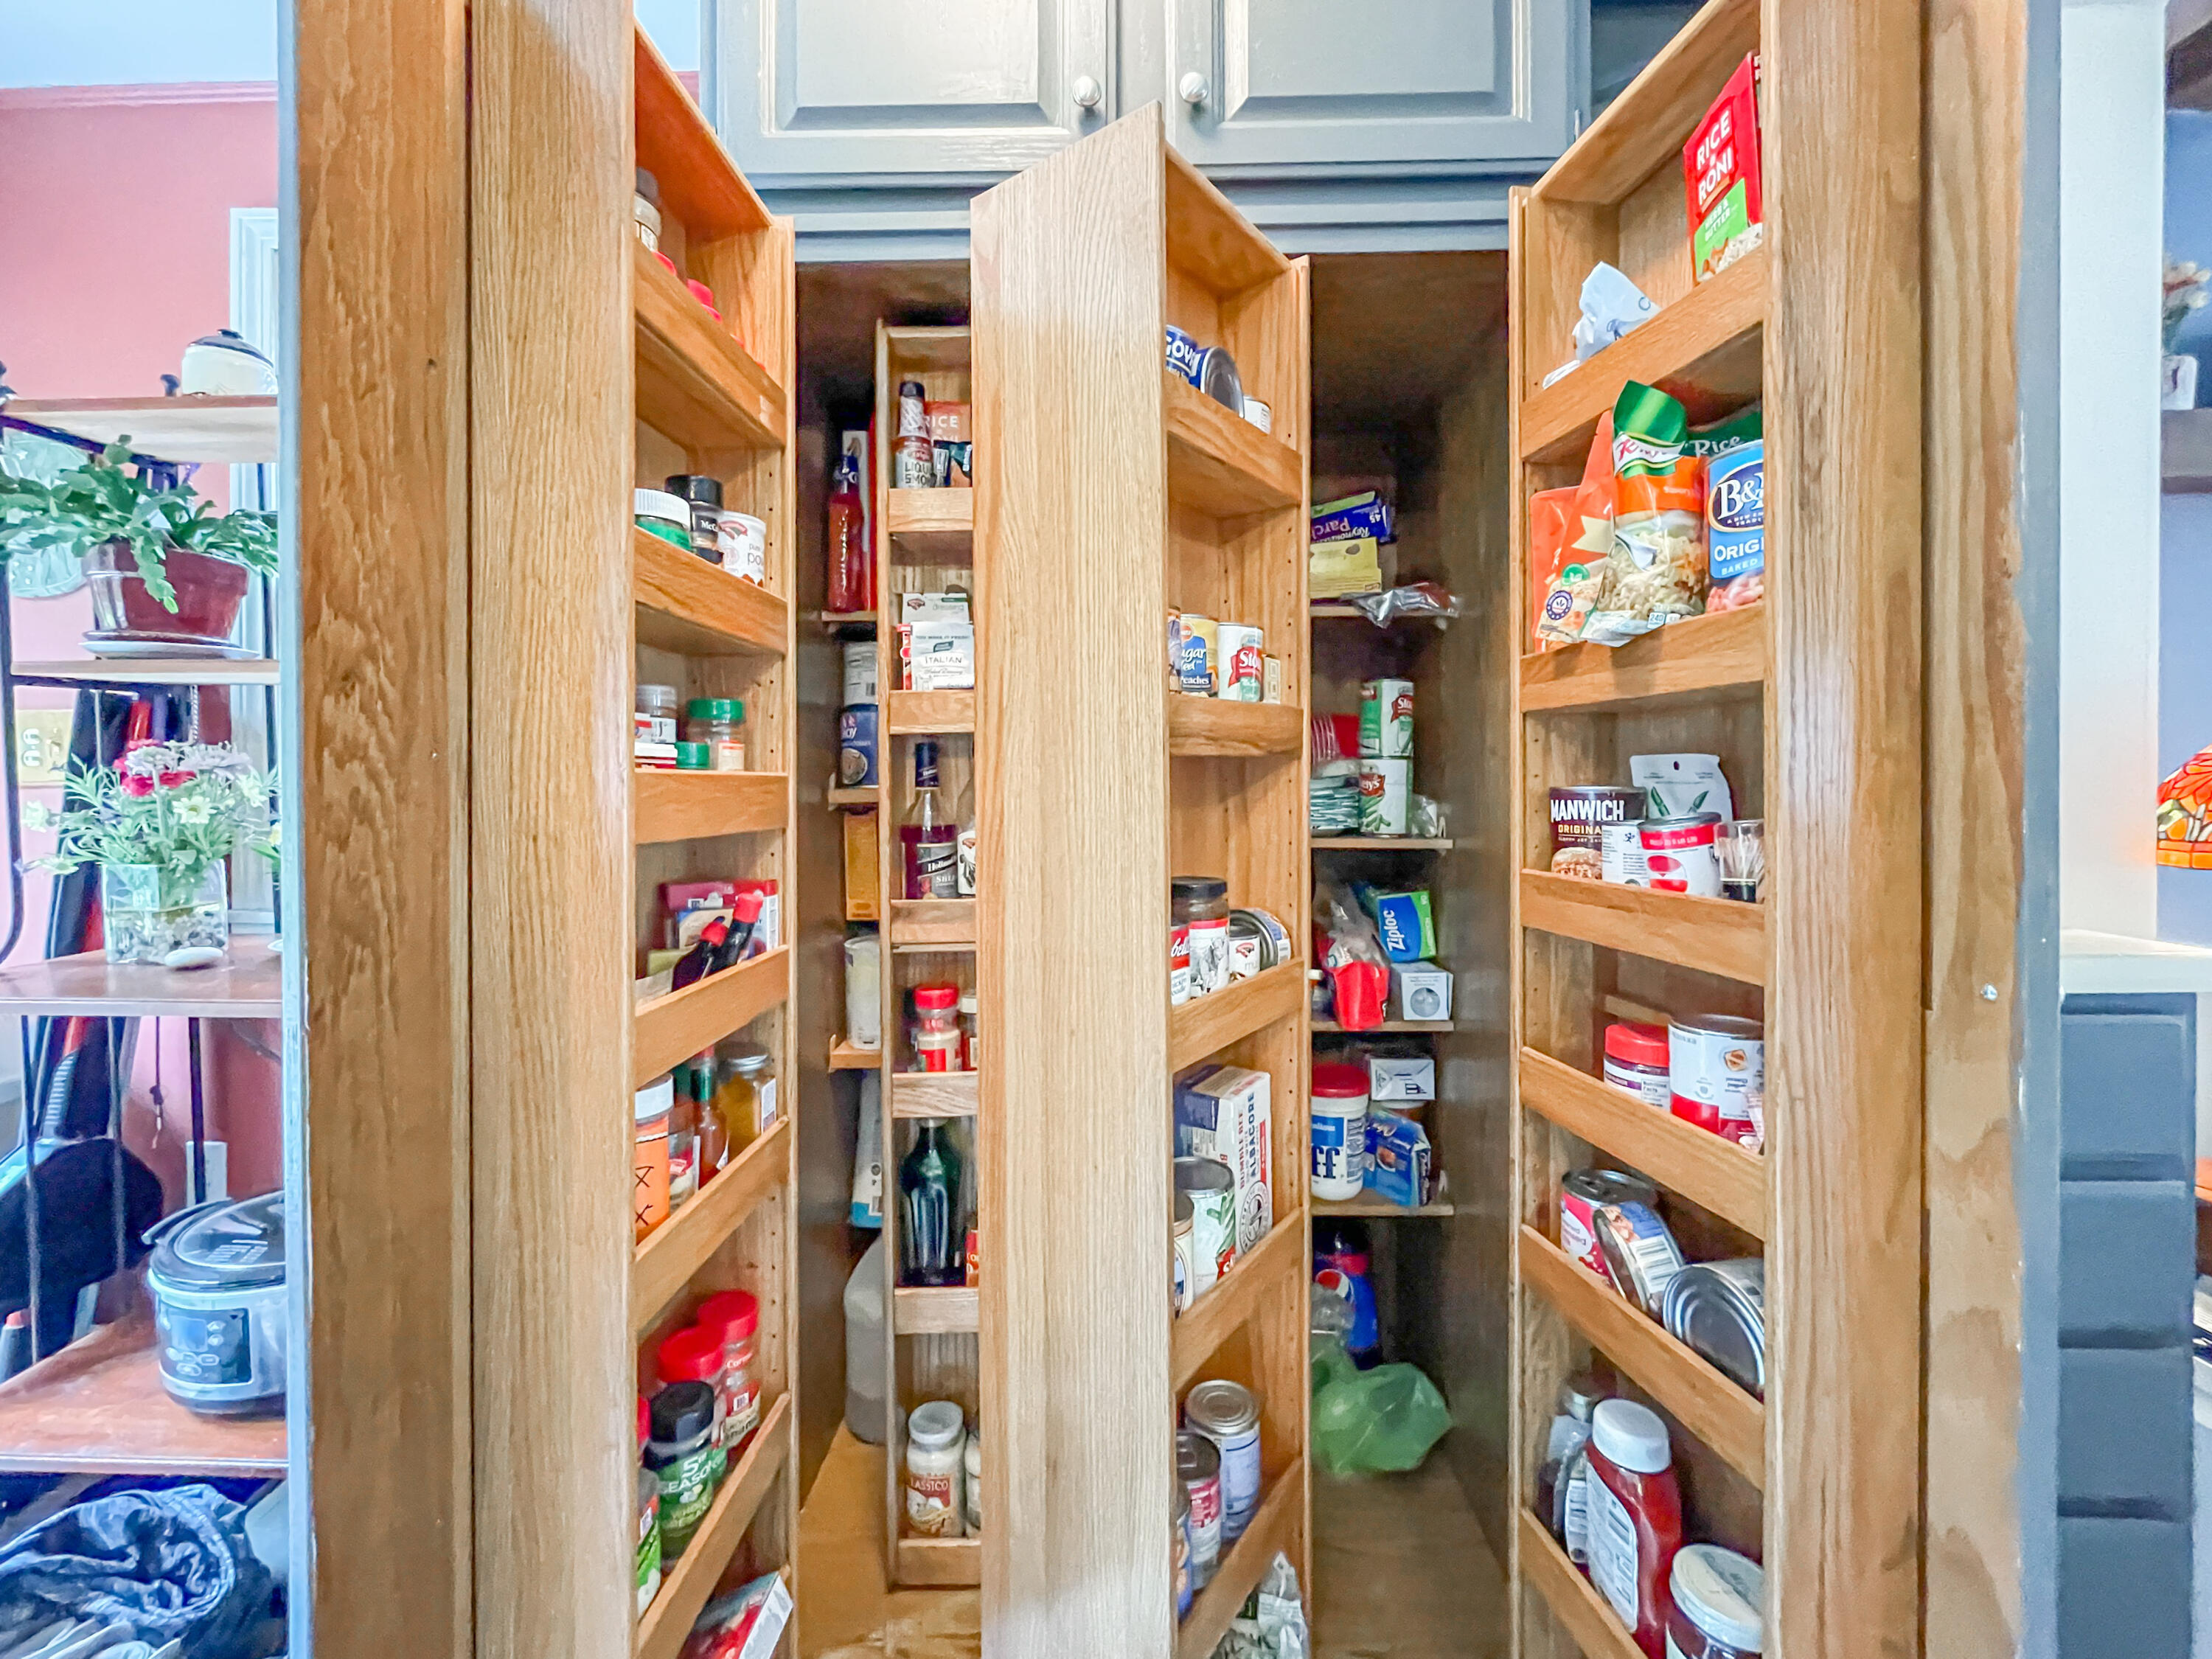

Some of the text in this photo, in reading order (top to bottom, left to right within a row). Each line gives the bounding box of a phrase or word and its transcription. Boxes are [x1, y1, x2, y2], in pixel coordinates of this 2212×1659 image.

[1697, 111, 1730, 170] RICE
[1698, 147, 1732, 206] RONI
[1705, 208, 1731, 242] BUTTER
[1694, 437, 1741, 459] Rice
[1721, 558, 1759, 576] BAKED
[925, 656, 962, 664] ITALIAN
[1551, 799, 1625, 823] MANWICH
[1558, 825, 1602, 835] ORIGINA
[1382, 909, 1406, 952] Ziploc
[1247, 1091, 1256, 1178] ALBACORE
